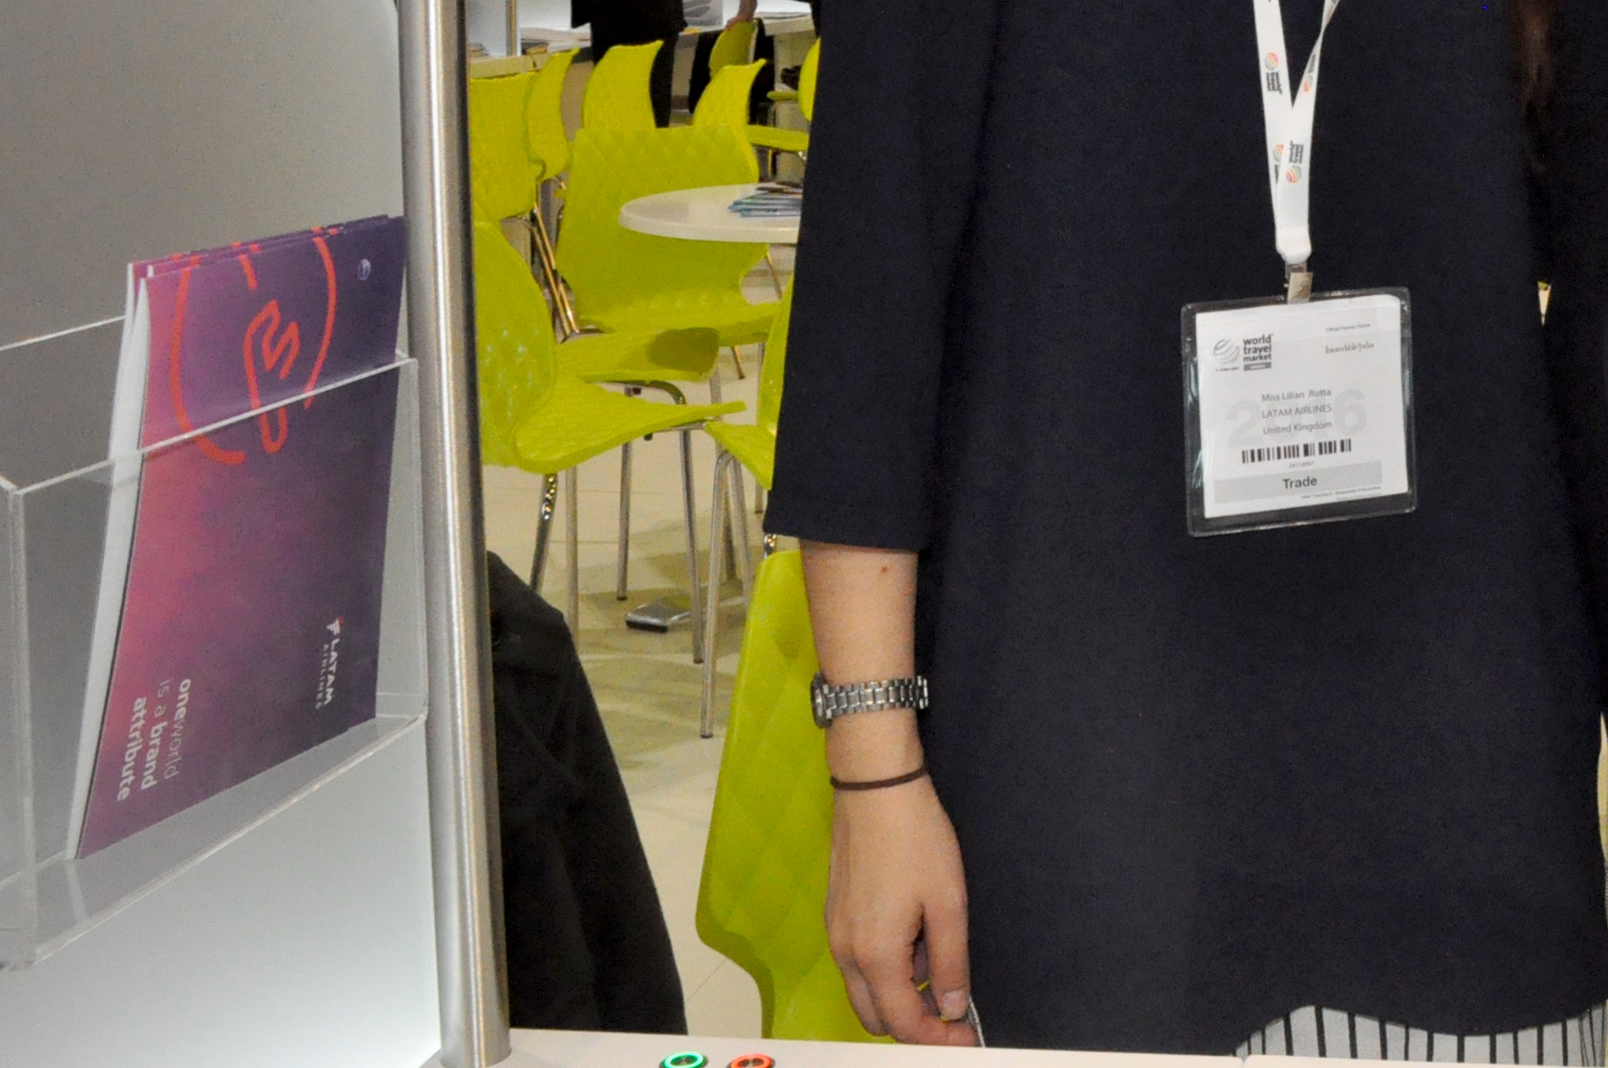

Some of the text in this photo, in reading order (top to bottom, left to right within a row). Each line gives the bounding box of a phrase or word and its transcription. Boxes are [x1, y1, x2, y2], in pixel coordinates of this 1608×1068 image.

[1243, 334, 1271, 345] world
[1243, 344, 1271, 355] travel
[1243, 353, 1271, 362] market
[1261, 393, 1280, 402] Miss
[1308, 389, 1331, 397] Rotta
[1262, 404, 1332, 418] LATAM AIRLINES
[1263, 421, 1332, 435] United Kingdom
[1282, 476, 1318, 489] Trade
[324, 638, 340, 706] LATAM
[157, 678, 174, 697] is
[164, 678, 191, 779] oneworld
[117, 696, 146, 801] attribute
[140, 722, 168, 790] brand
